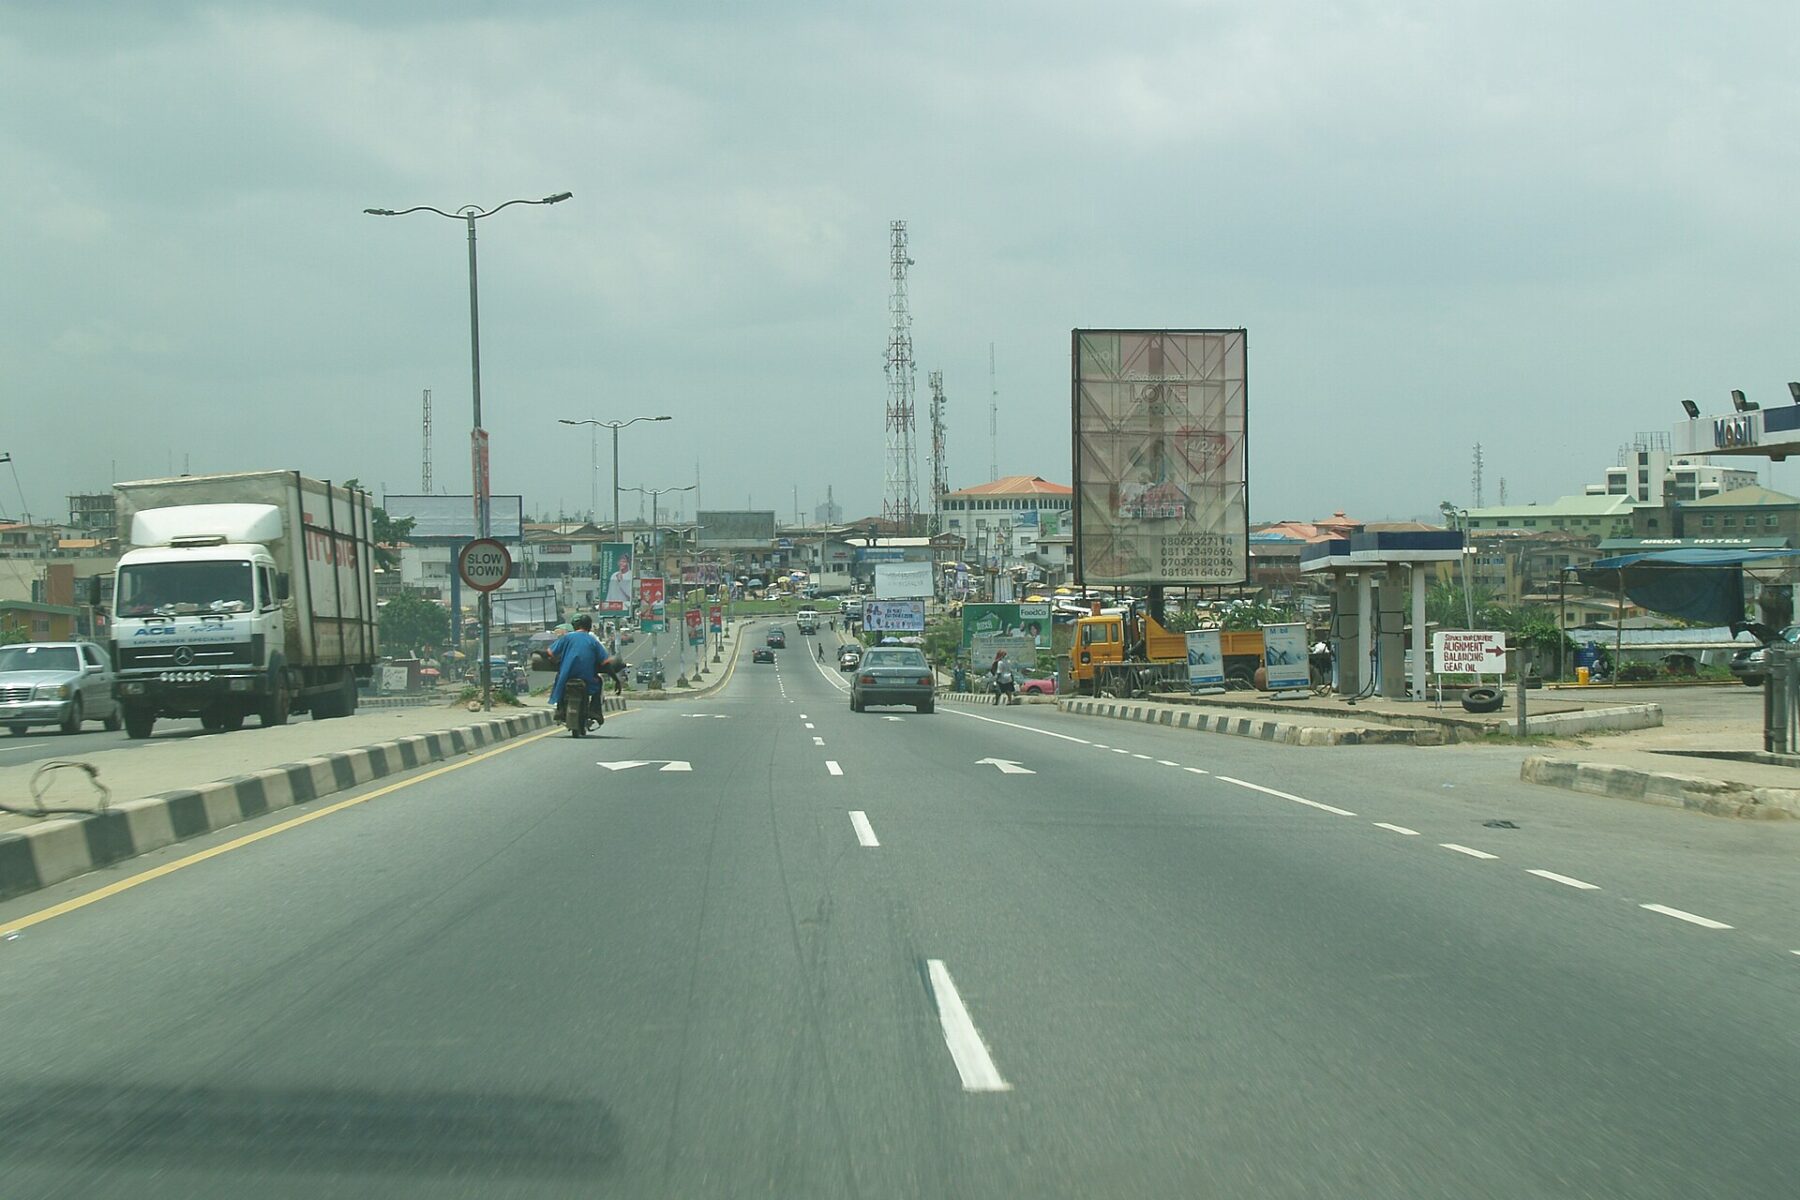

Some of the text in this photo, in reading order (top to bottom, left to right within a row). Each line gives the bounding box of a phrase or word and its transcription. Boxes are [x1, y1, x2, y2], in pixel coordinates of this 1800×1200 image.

[1714, 416, 1753, 448] Mobil
[468, 553, 502, 564] SLOW
[467, 565, 503, 577] DOWN
[1161, 568, 1233, 577] 08184164667
[1021, 608, 1046, 616] FoodCo
[134, 627, 176, 636] ACE
[1444, 641, 1484, 651] ALIGNMENT
[1444, 652, 1484, 662] BALANCING
[1444, 663, 1477, 672] GEAR OIL
